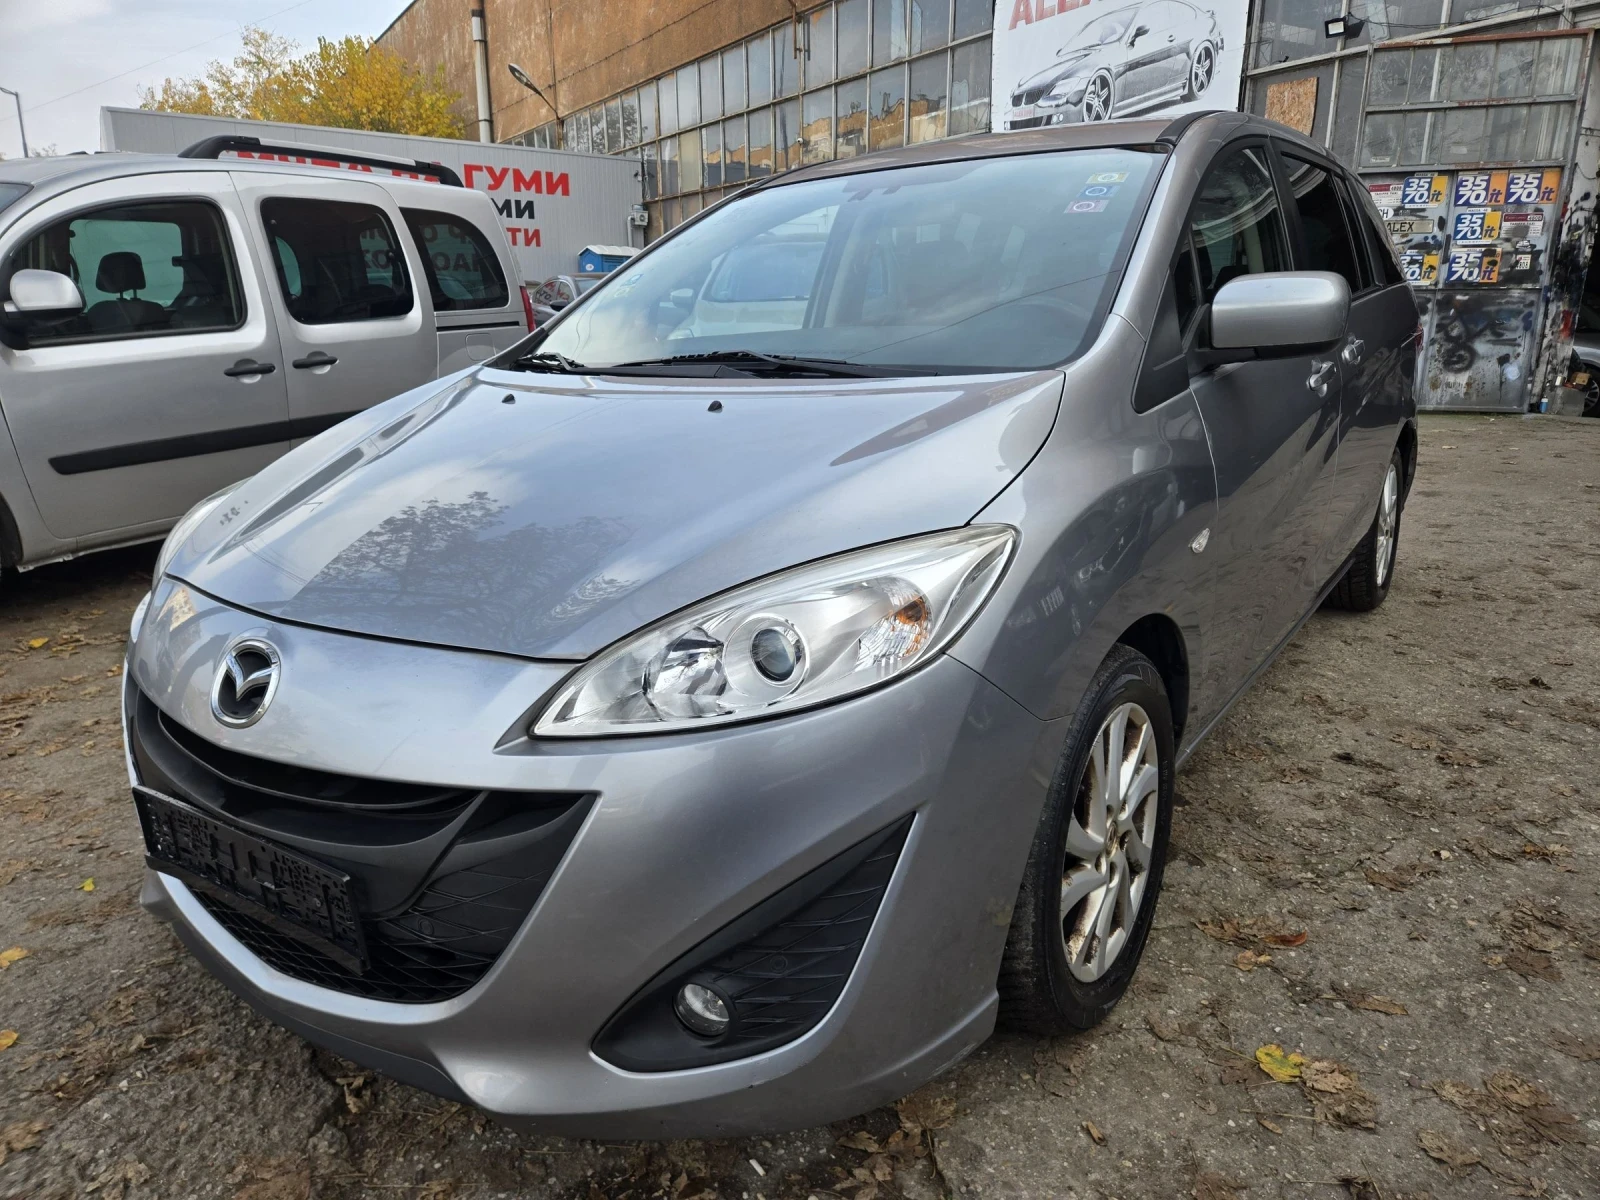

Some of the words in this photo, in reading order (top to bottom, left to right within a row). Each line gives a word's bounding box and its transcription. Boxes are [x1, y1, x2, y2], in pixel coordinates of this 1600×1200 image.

[463, 163, 570, 196] ГУМИ
[1405, 178, 1431, 191] 35
[1458, 175, 1489, 190] 35
[1509, 173, 1541, 188] 35
[490, 197, 535, 220] МИ
[1457, 214, 1484, 227] 35
[506, 227, 541, 247] ТИ
